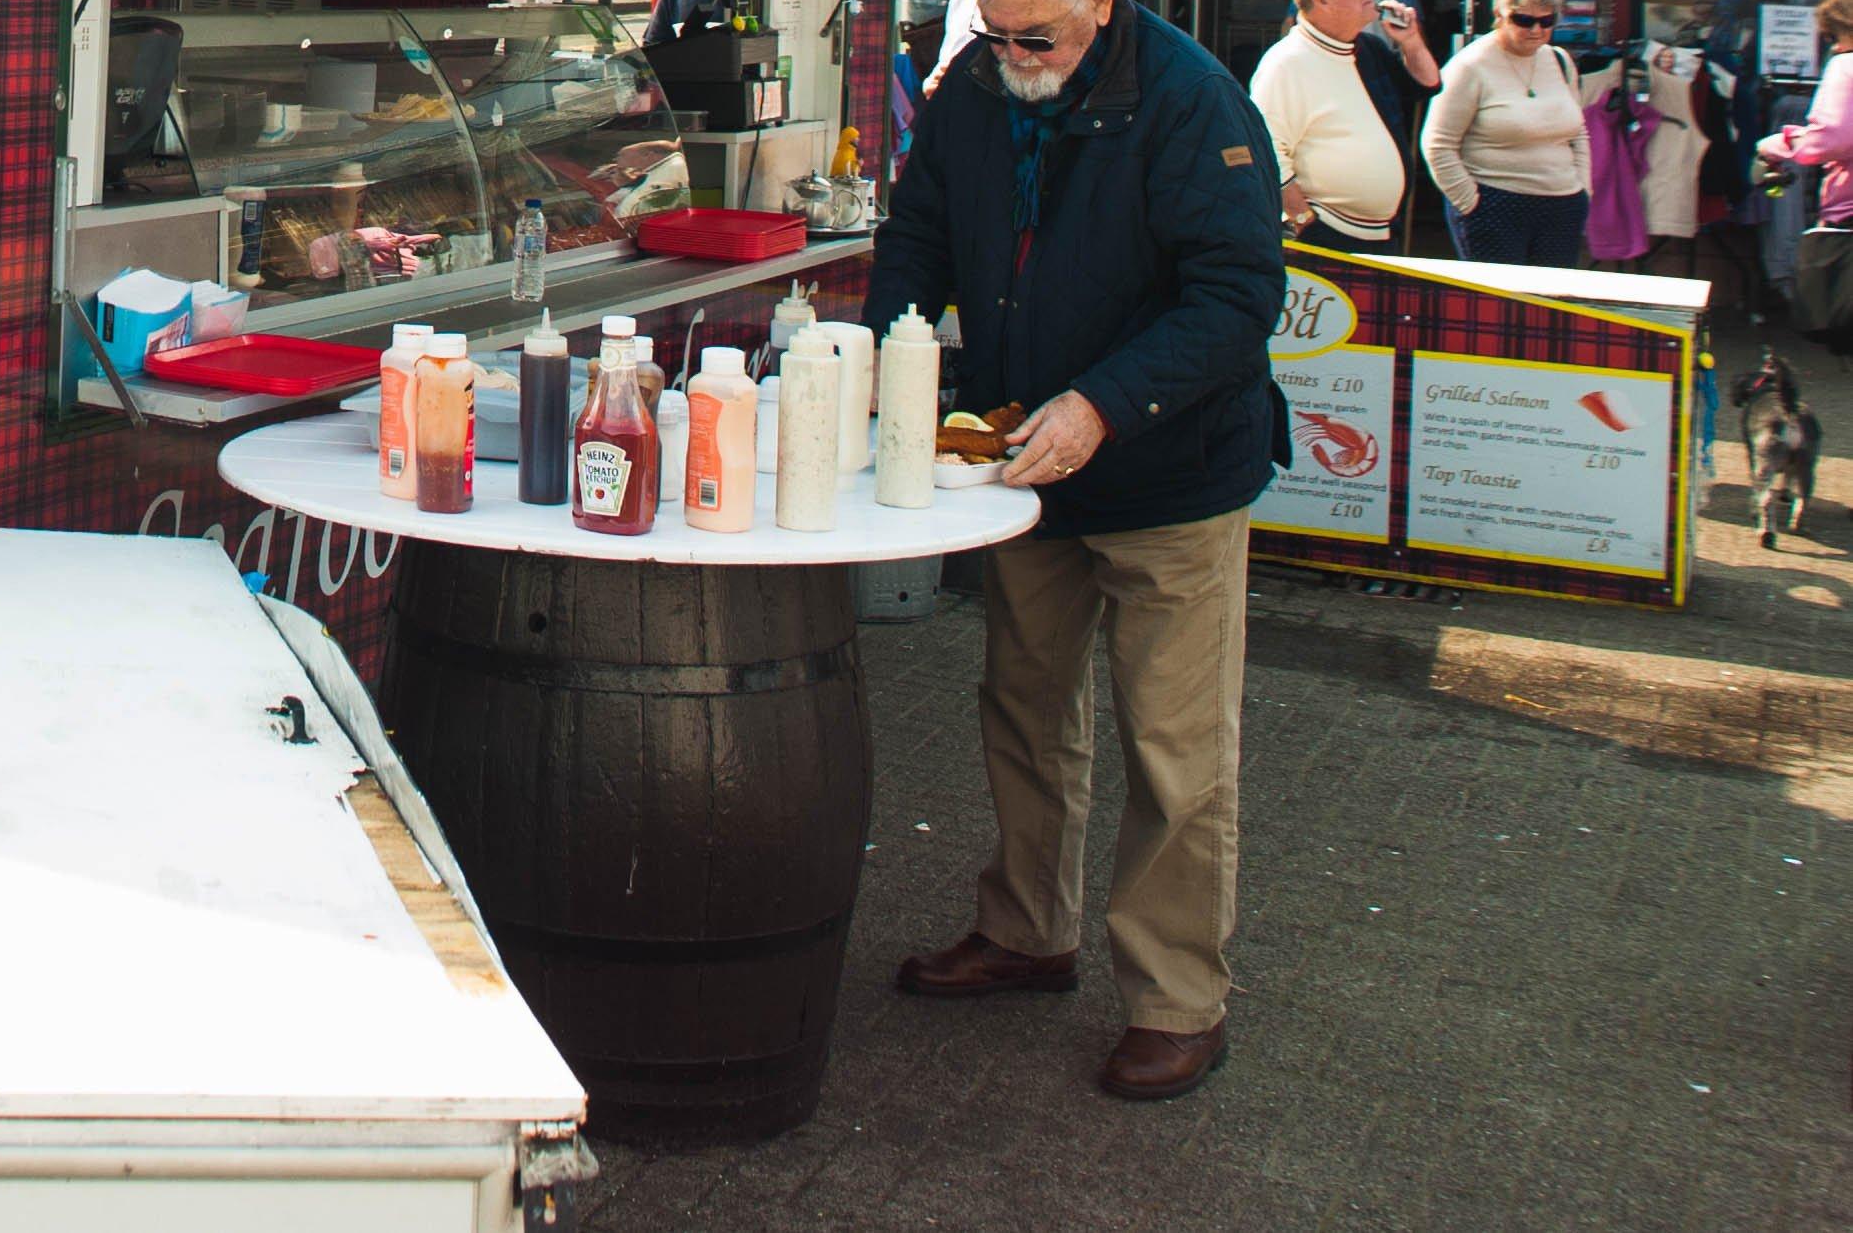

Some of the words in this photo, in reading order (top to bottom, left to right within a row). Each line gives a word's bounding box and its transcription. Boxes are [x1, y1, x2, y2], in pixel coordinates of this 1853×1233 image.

[1283, 286, 1317, 313] ot
[1273, 370, 1320, 388] stines
[1331, 377, 1364, 393] £10
[1425, 383, 1484, 404] Grilled
[1486, 390, 1551, 410] Salmon
[586, 450, 615, 464] HEINZ
[1585, 453, 1621, 470] £10
[585, 464, 619, 477] TOMATO
[1423, 465, 1456, 486] Top
[1460, 469, 1522, 490] Toastie
[1330, 501, 1364, 519] £10
[1586, 537, 1611, 553] £8
